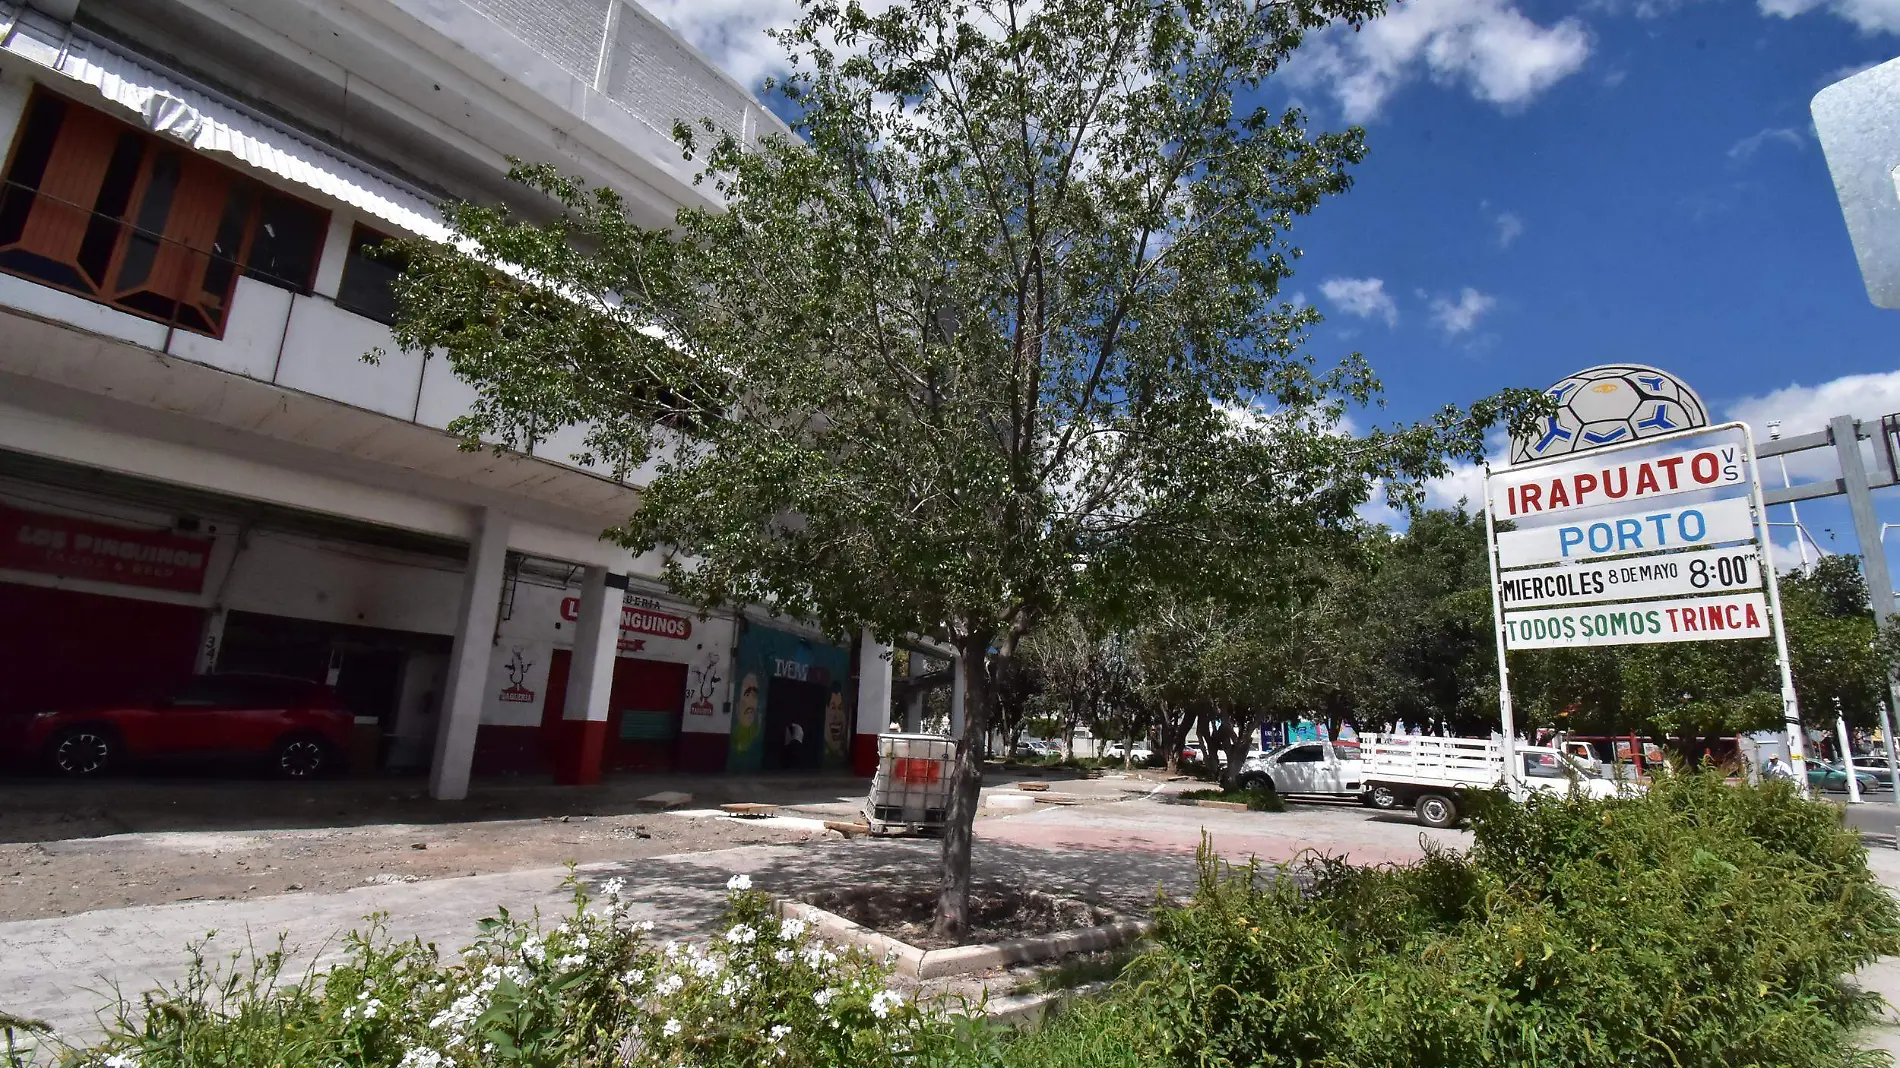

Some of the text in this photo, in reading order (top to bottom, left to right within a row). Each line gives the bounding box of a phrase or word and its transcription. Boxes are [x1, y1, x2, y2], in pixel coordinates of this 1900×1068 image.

[1507, 452, 1720, 515] IRAPUATO
[17, 525, 67, 549] LOS
[1558, 509, 1706, 557] PORTO
[1502, 570, 1605, 602] MIERCOLES
[1608, 569, 1619, 584] 8
[1620, 567, 1638, 583] DE
[1639, 562, 1678, 582] MAYO
[1688, 555, 1748, 589] 8:00
[1506, 603, 1761, 642] TODOS SOMOS TRINCA
